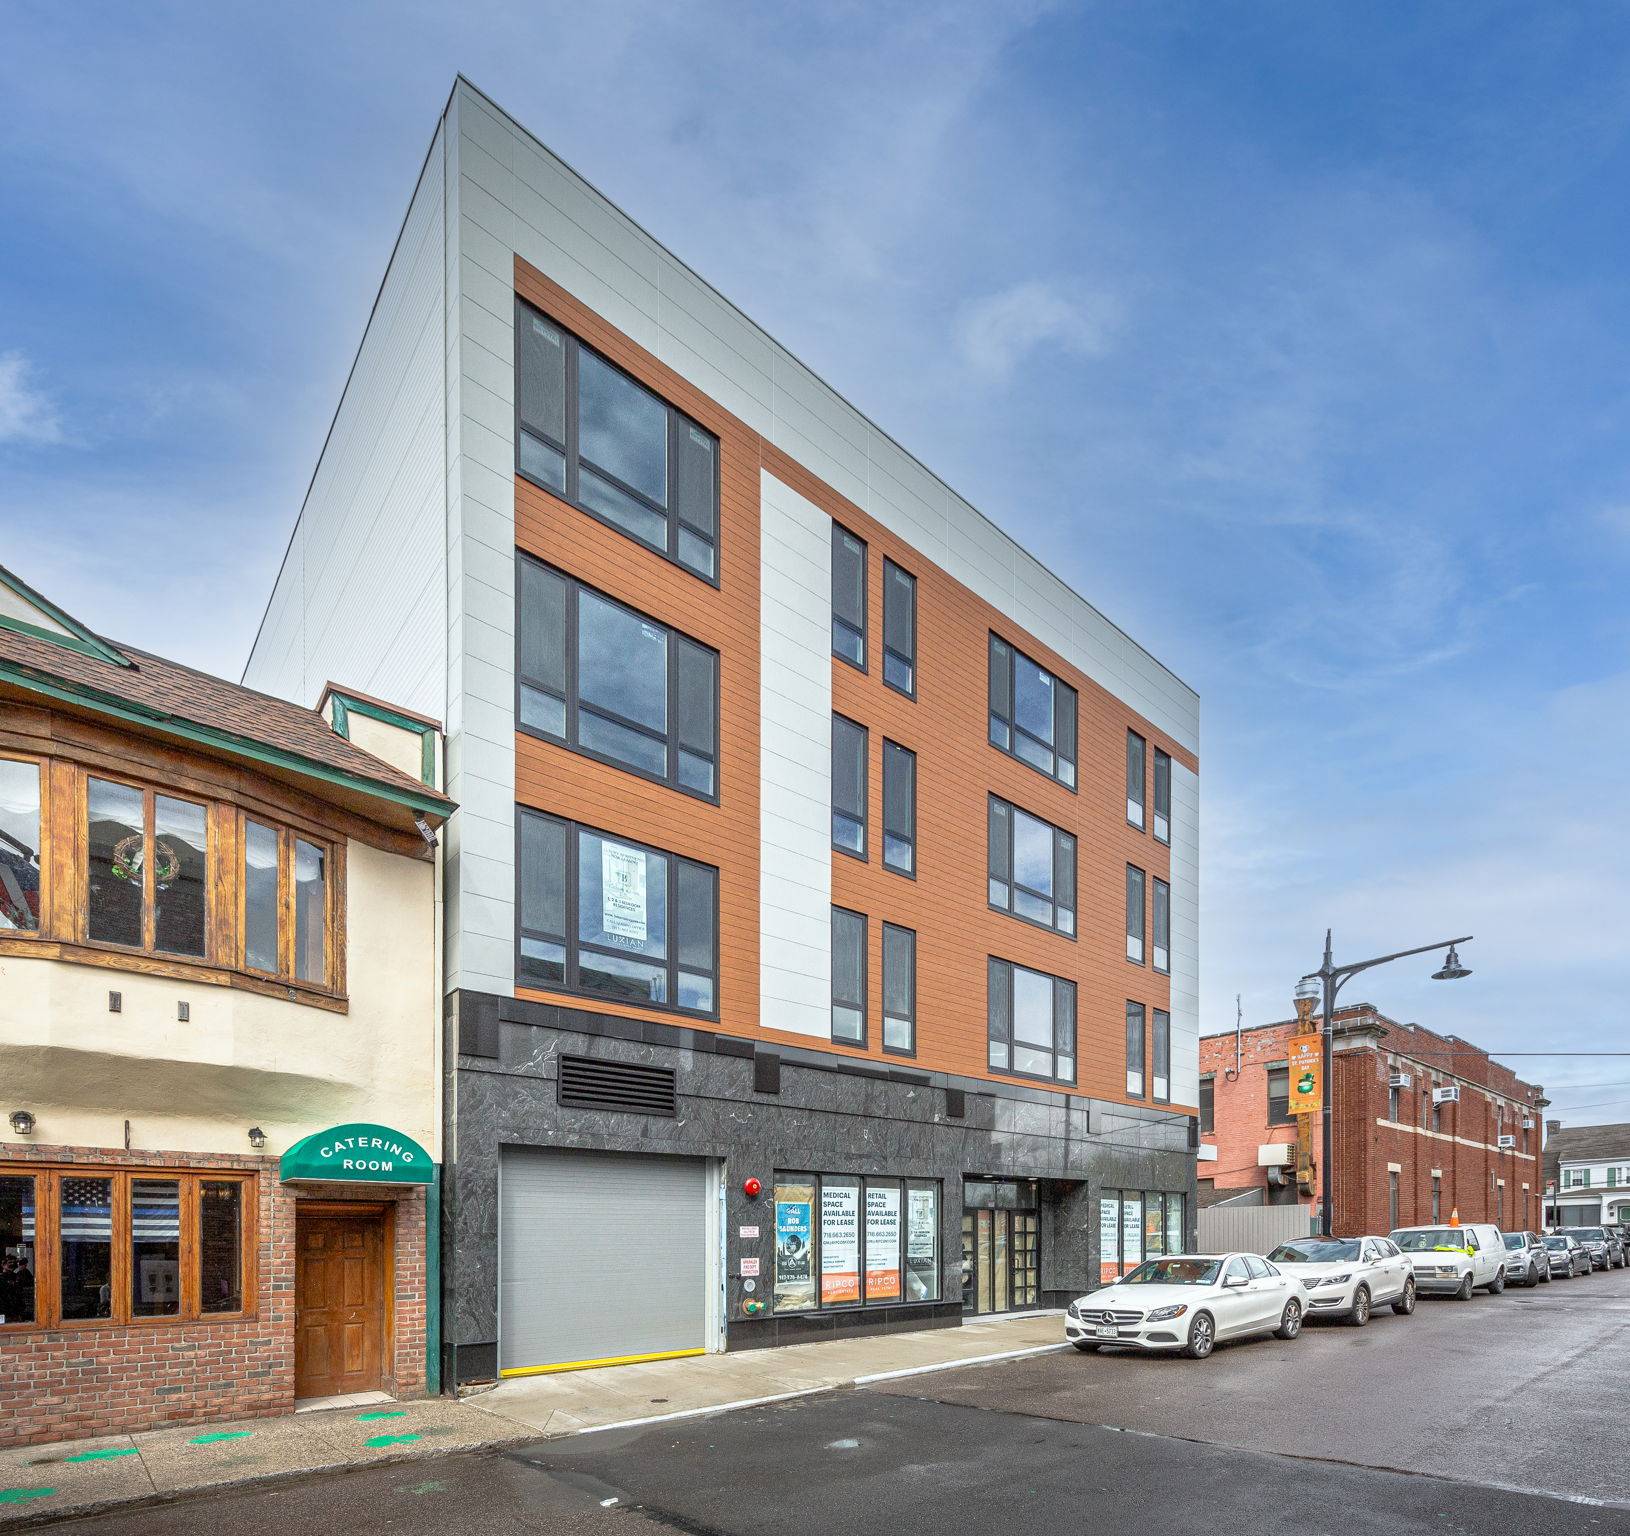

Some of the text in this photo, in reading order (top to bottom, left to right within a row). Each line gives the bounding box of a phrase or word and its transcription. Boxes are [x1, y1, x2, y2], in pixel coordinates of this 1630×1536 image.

[608, 934, 643, 947] LUXIAN
[320, 1137, 413, 1162] CATERING
[343, 1159, 392, 1172] ROOM
[825, 1280, 854, 1288] RIPCO
[869, 1277, 896, 1285] RIPCO
